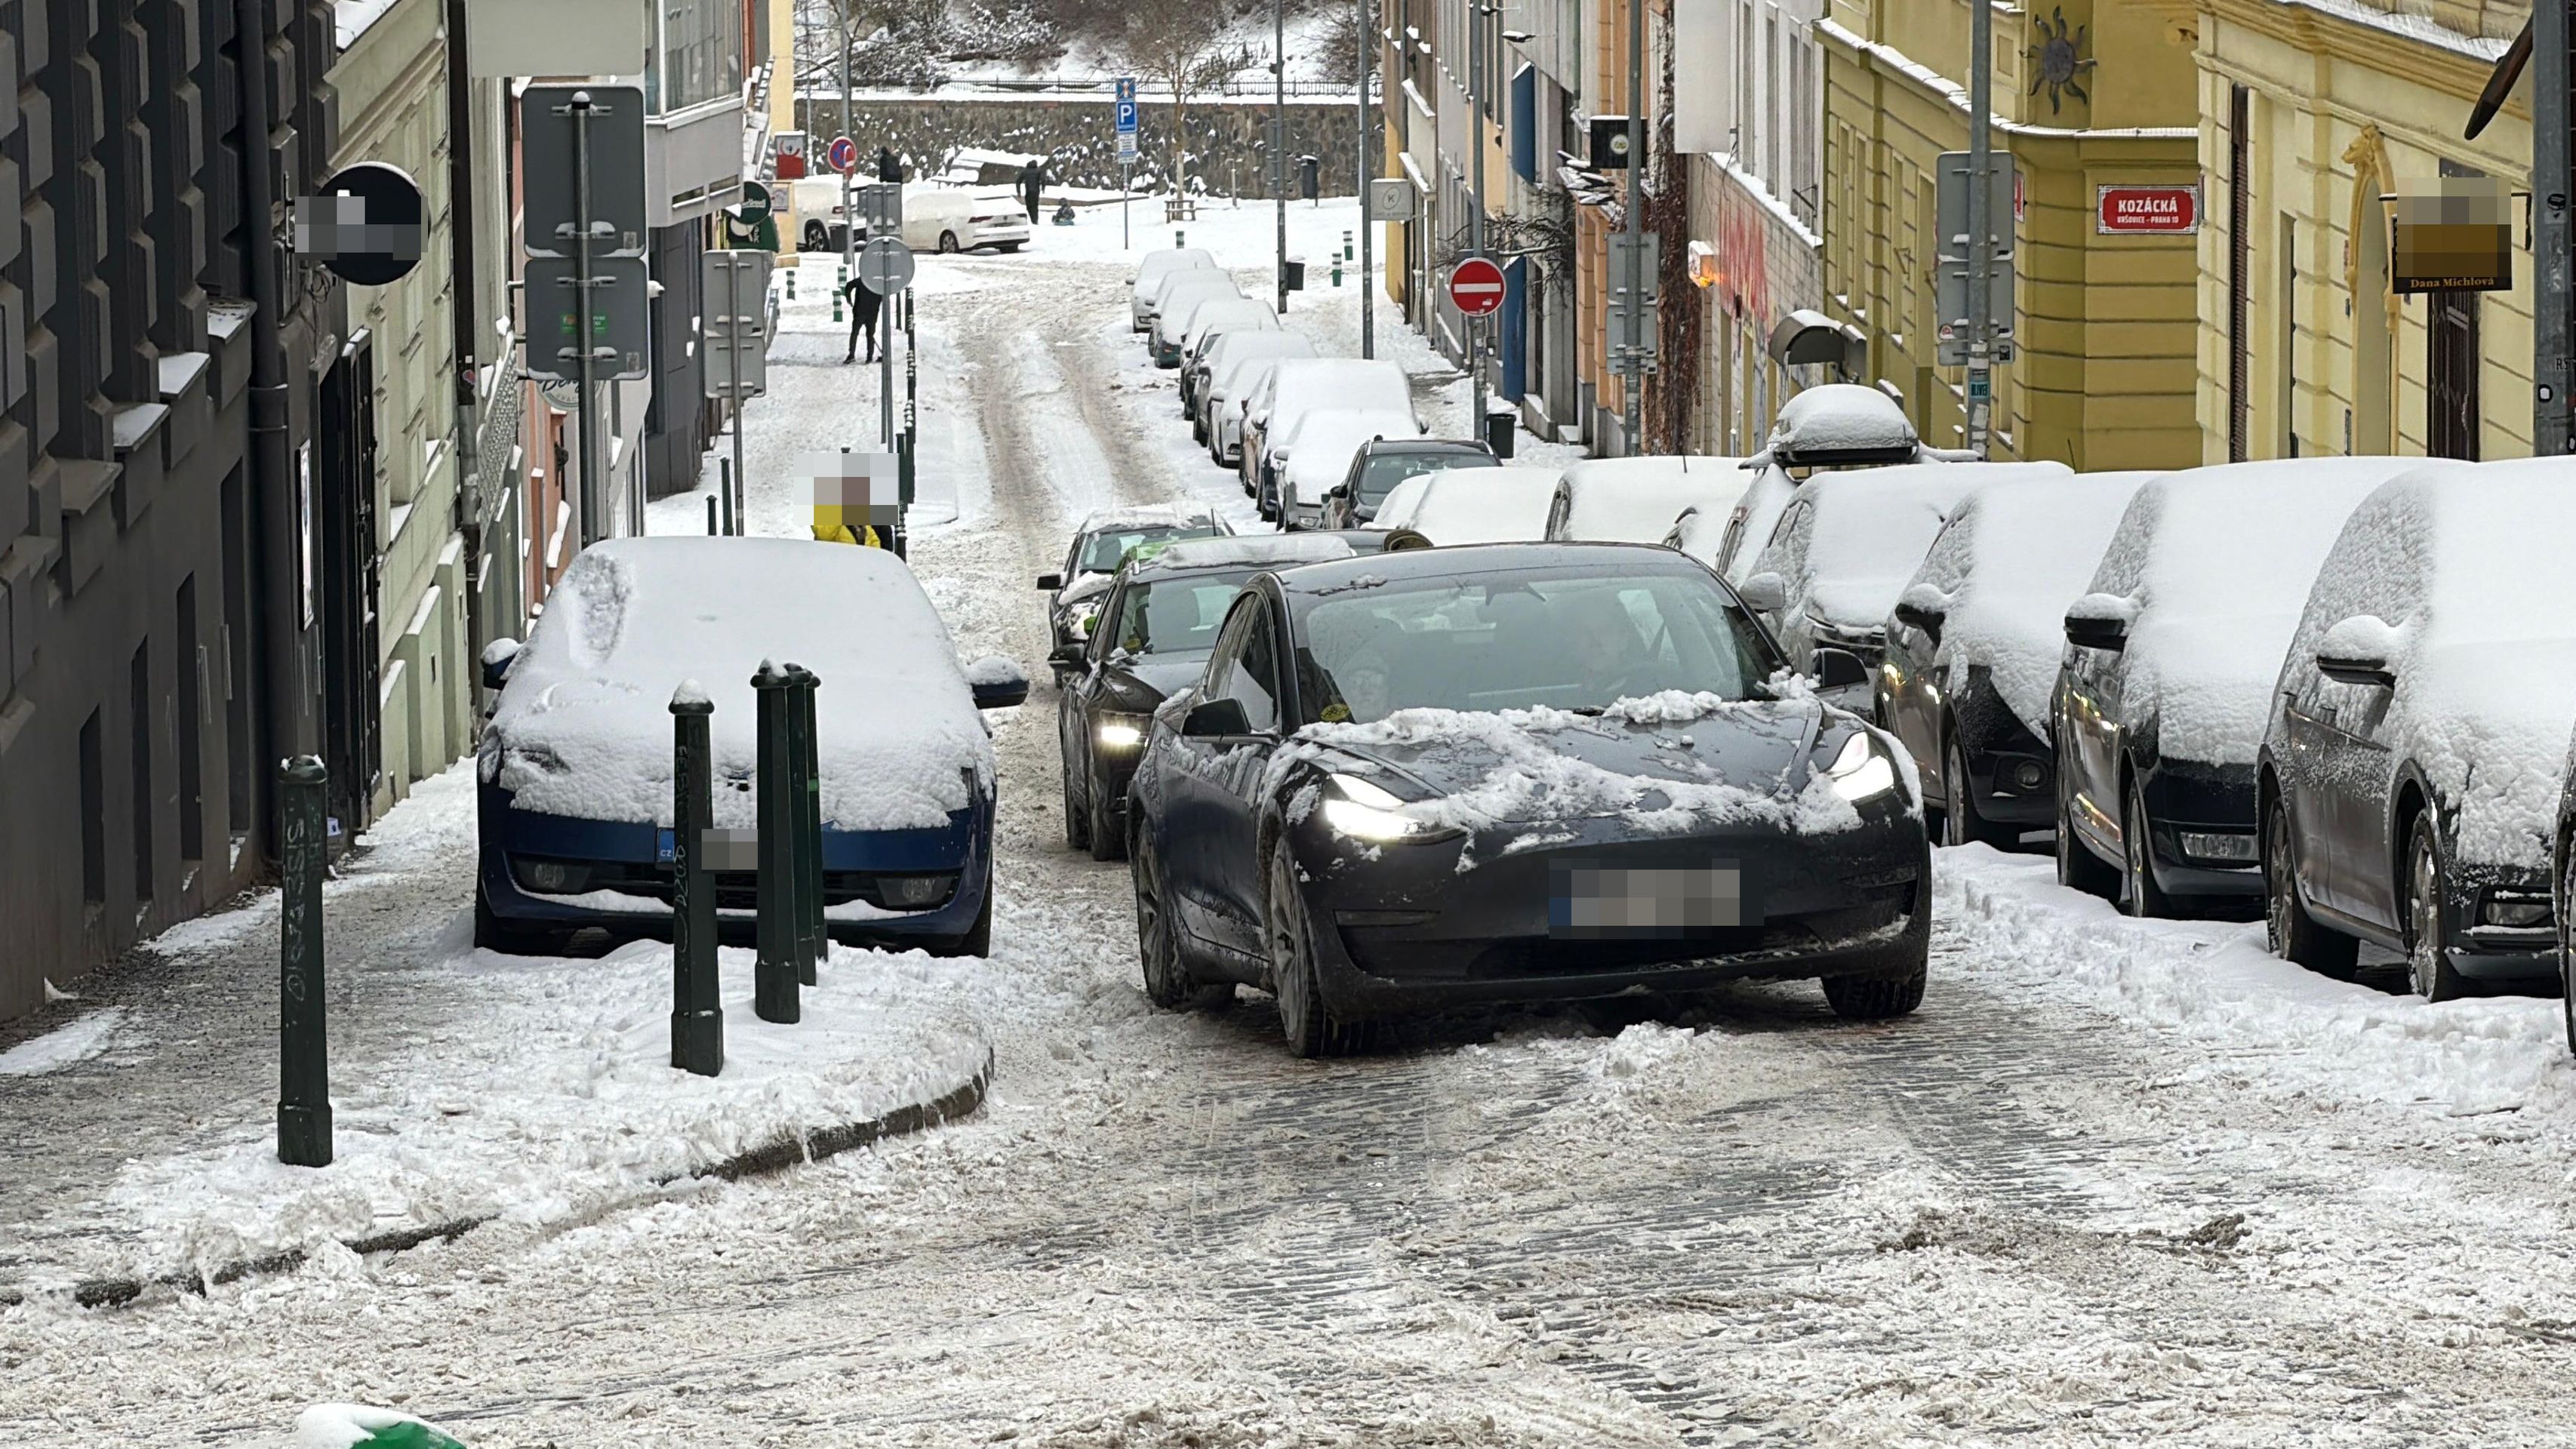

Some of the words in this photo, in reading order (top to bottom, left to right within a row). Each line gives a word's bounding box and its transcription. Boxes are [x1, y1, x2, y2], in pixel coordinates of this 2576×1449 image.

[1120, 104, 1132, 124] P
[2118, 196, 2177, 213] KOZÁCKÁ
[2411, 278, 2440, 288] Dana
[2442, 277, 2494, 287] Michlová
[660, 849, 672, 857] CZ
